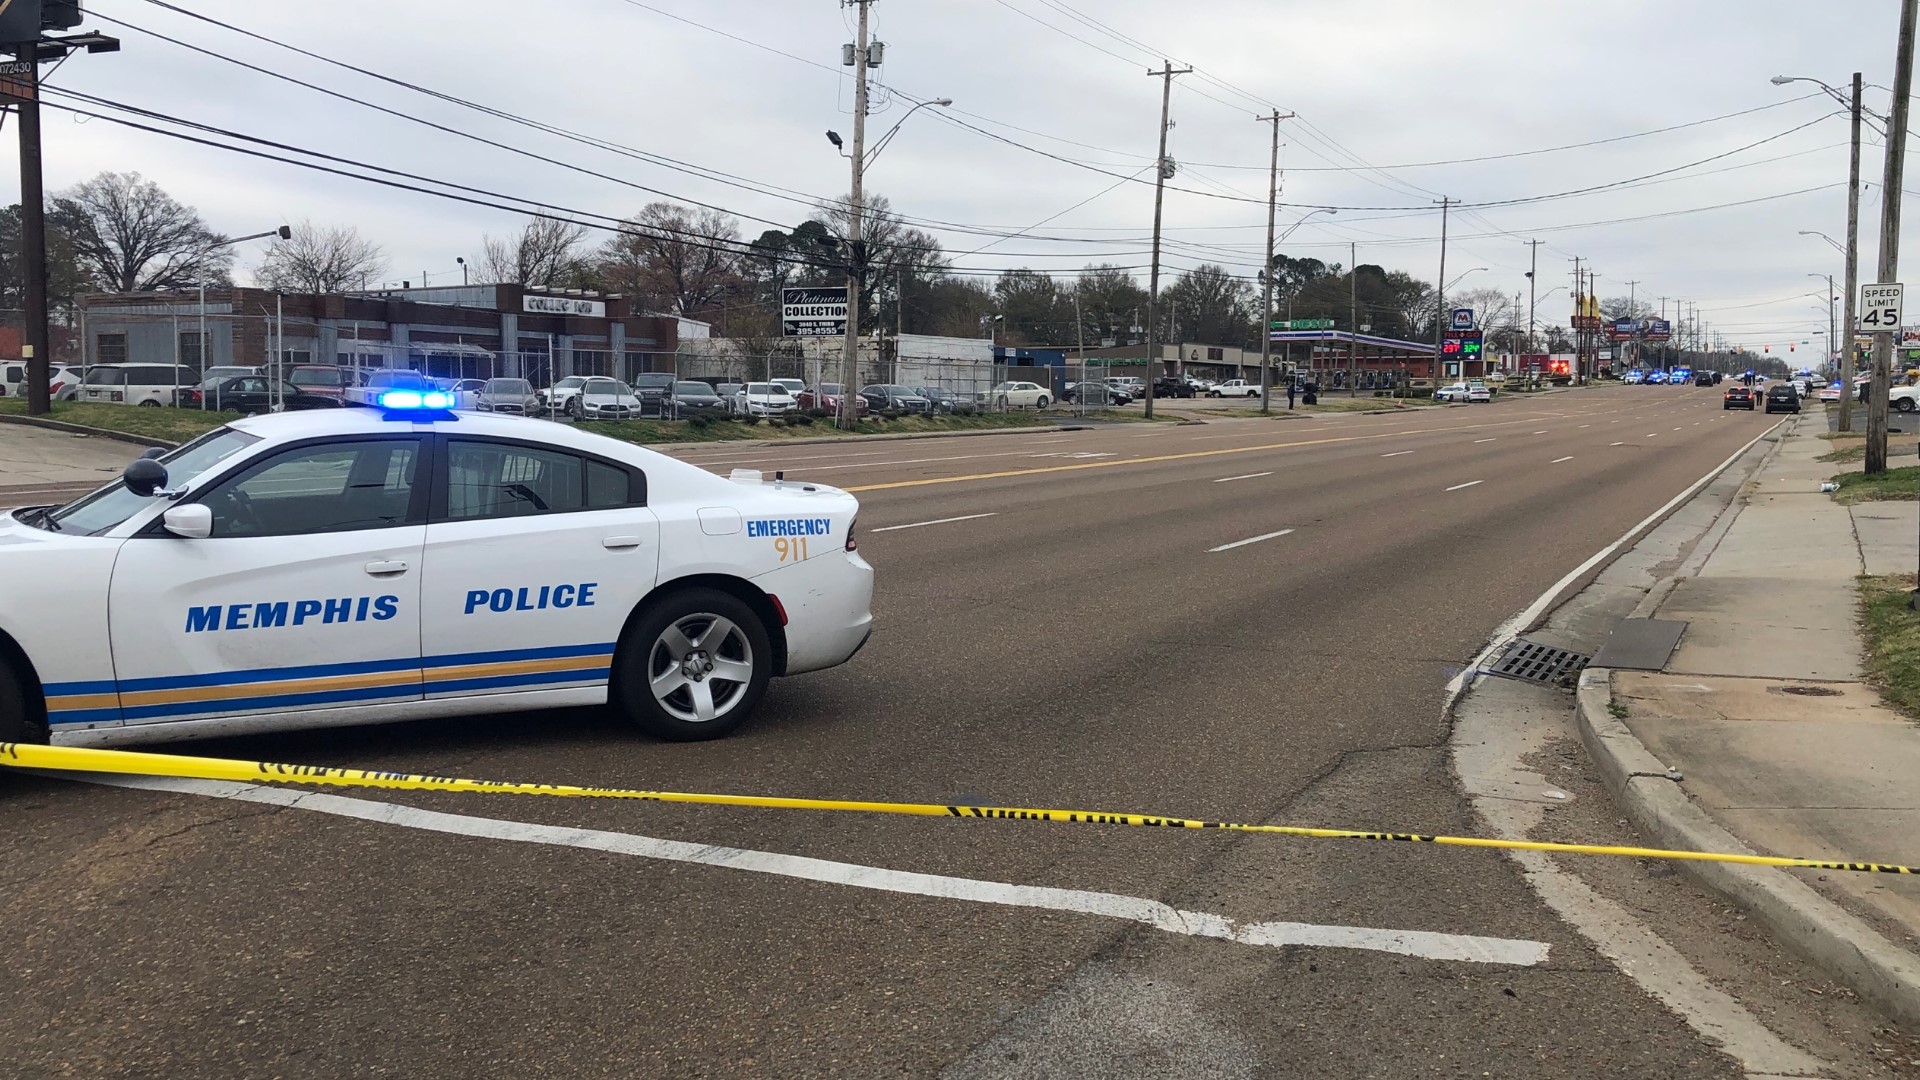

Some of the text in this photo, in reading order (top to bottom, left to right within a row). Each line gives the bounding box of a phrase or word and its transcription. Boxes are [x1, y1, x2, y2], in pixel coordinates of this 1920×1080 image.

[786, 290, 847, 303] Platinum
[1864, 289, 1900, 298] SPEED
[1867, 299, 1896, 307] LIMIT
[785, 306, 847, 317] COLLECTION
[1863, 309, 1898, 326] 45
[1290, 318, 1331, 329] DIESEL
[797, 327, 838, 335] 395-8555
[747, 519, 830, 537] EMERGENCY
[775, 536, 807, 561] 911
[464, 582, 597, 615] POLICE
[185, 595, 399, 633] MEMPHIS
